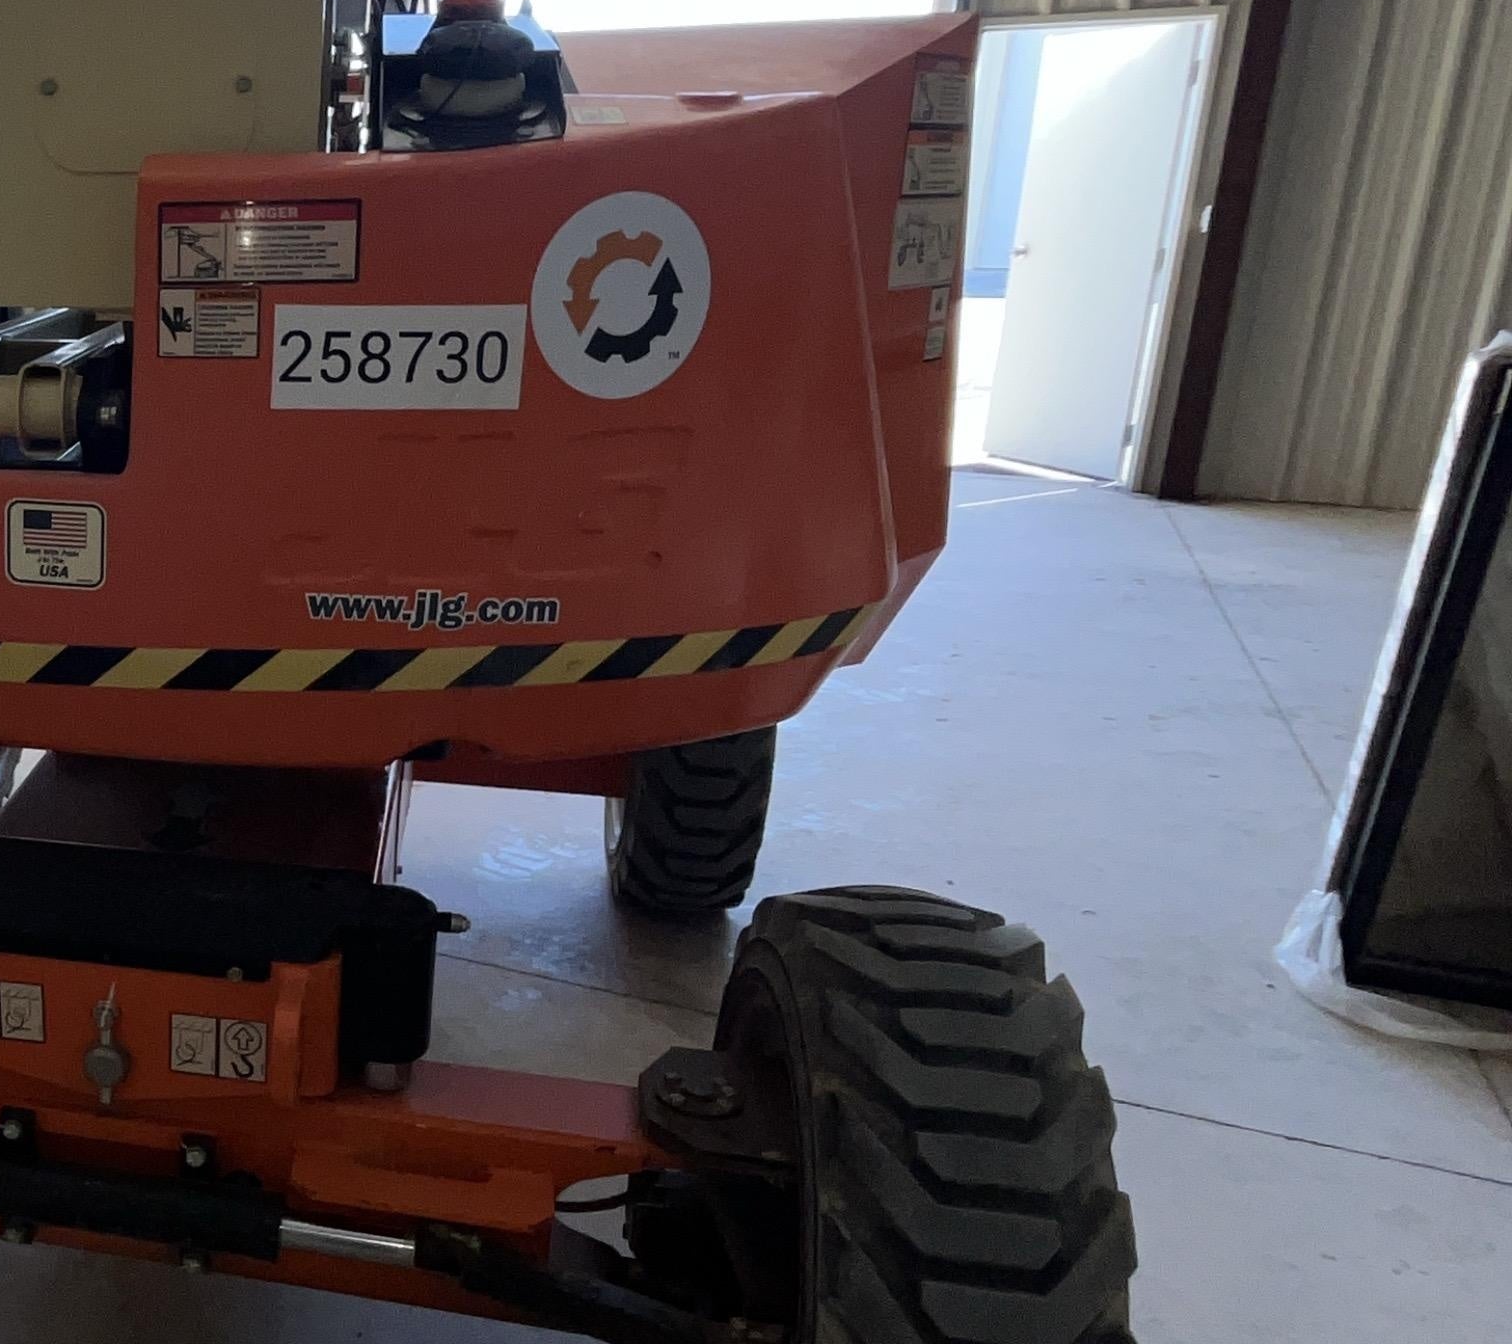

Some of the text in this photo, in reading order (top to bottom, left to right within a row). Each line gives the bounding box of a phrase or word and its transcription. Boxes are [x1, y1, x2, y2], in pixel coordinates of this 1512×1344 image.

[234, 207, 299, 220] DANGER
[278, 329, 508, 383] 258730
[39, 564, 69, 579] USA
[306, 590, 559, 630] www.jlg.com
